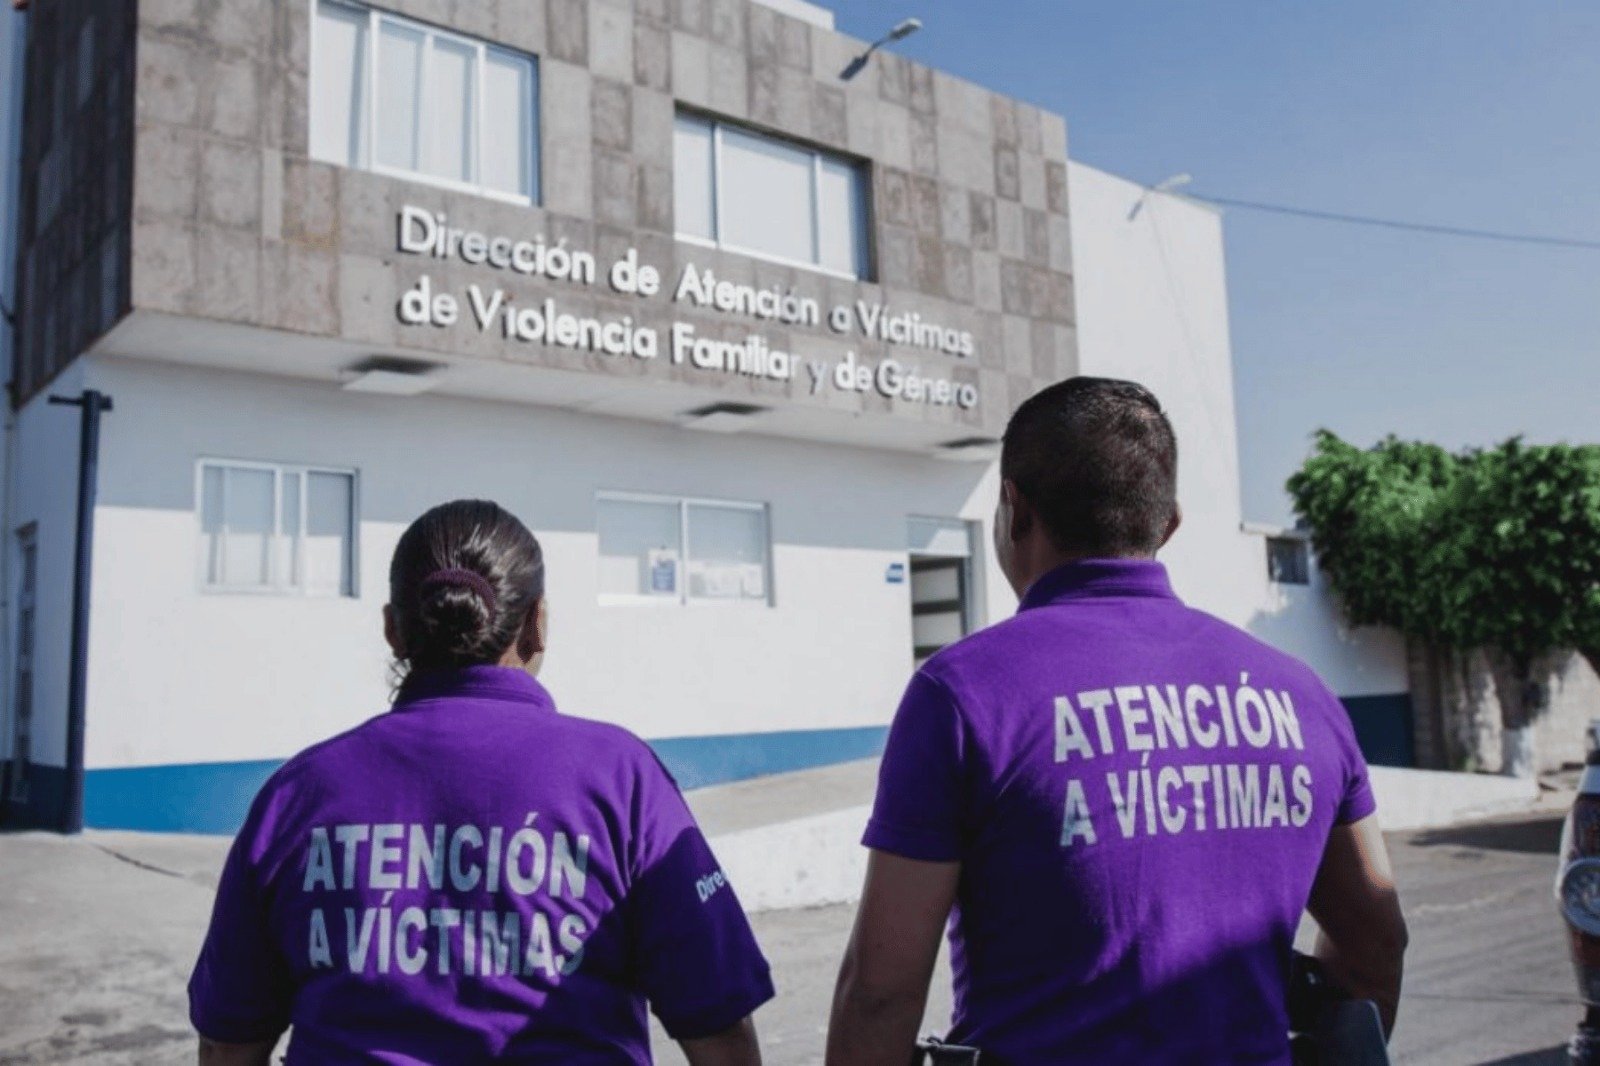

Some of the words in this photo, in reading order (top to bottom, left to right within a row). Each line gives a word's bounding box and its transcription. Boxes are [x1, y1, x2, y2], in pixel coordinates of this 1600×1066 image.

[399, 204, 596, 284] Dirección
[610, 248, 660, 296] de
[674, 262, 820, 326] Atención
[829, 304, 851, 333] a
[855, 300, 974, 357] Víctimas
[398, 274, 458, 327] de
[467, 284, 658, 358] Violencia
[671, 321, 799, 379] Familiar
[807, 359, 828, 395] y
[834, 351, 873, 393] de
[876, 358, 978, 409] Género
[1054, 671, 1304, 763] ATENCIÓN
[1060, 779, 1097, 847] A
[1106, 752, 1313, 838] VÍCTIMAS
[303, 812, 591, 900] ATENCIÓN
[696, 871, 726, 903] Dire
[309, 907, 334, 968] A
[345, 890, 587, 979] VÍCTIMAS
